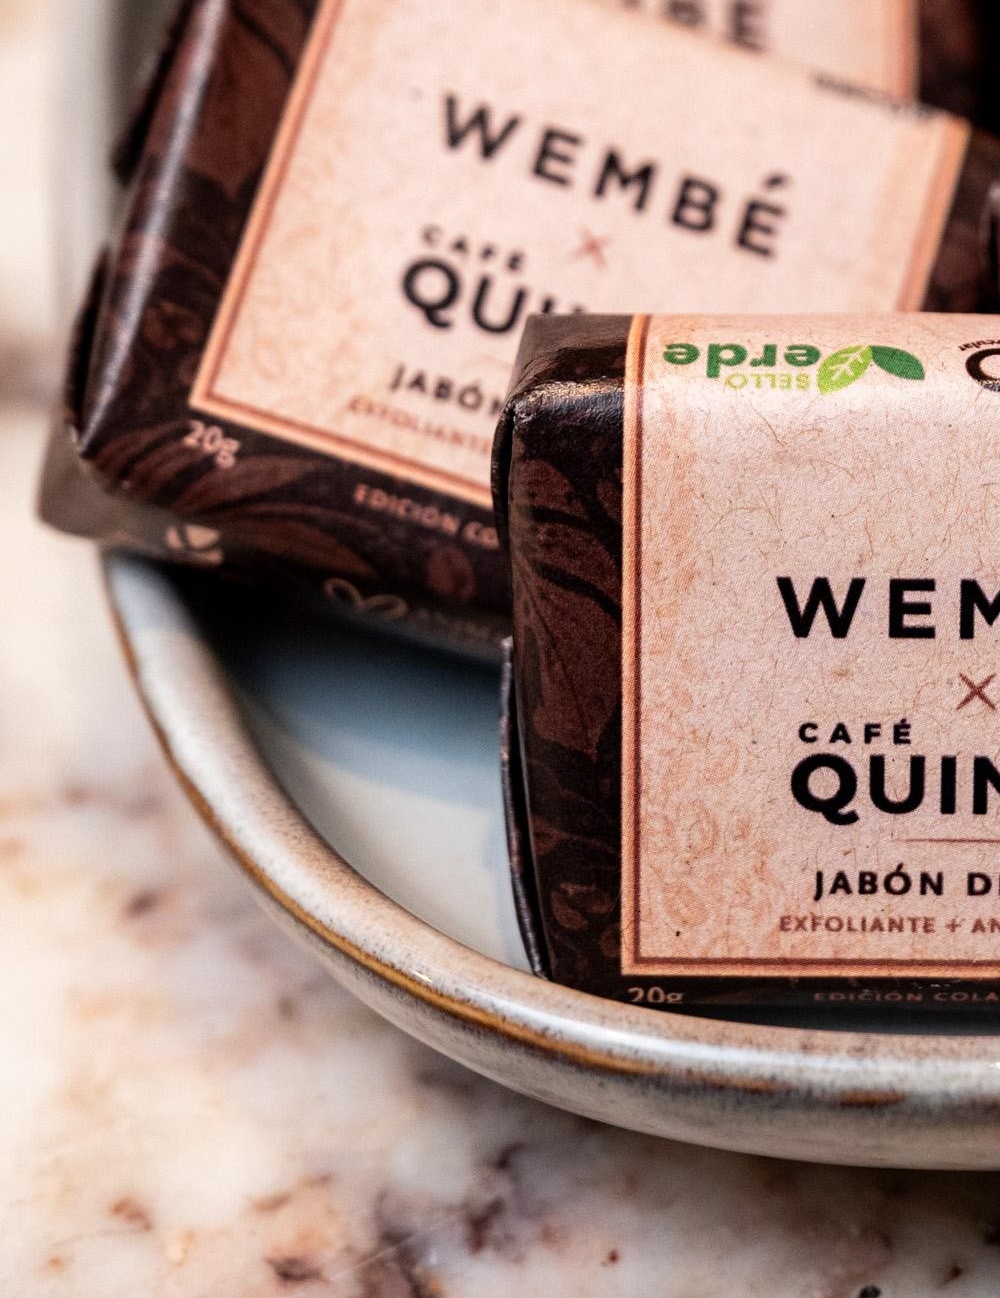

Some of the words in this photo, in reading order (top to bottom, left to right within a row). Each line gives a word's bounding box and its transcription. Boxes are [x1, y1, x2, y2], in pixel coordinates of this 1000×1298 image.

[443, 91, 790, 259] WEMBÉ
[724, 373, 810, 390] SELLO
[798, 718, 912, 745] CAFÉ
[813, 864, 945, 902] JABÓN
[778, 915, 936, 934] EXFOLIANTE
